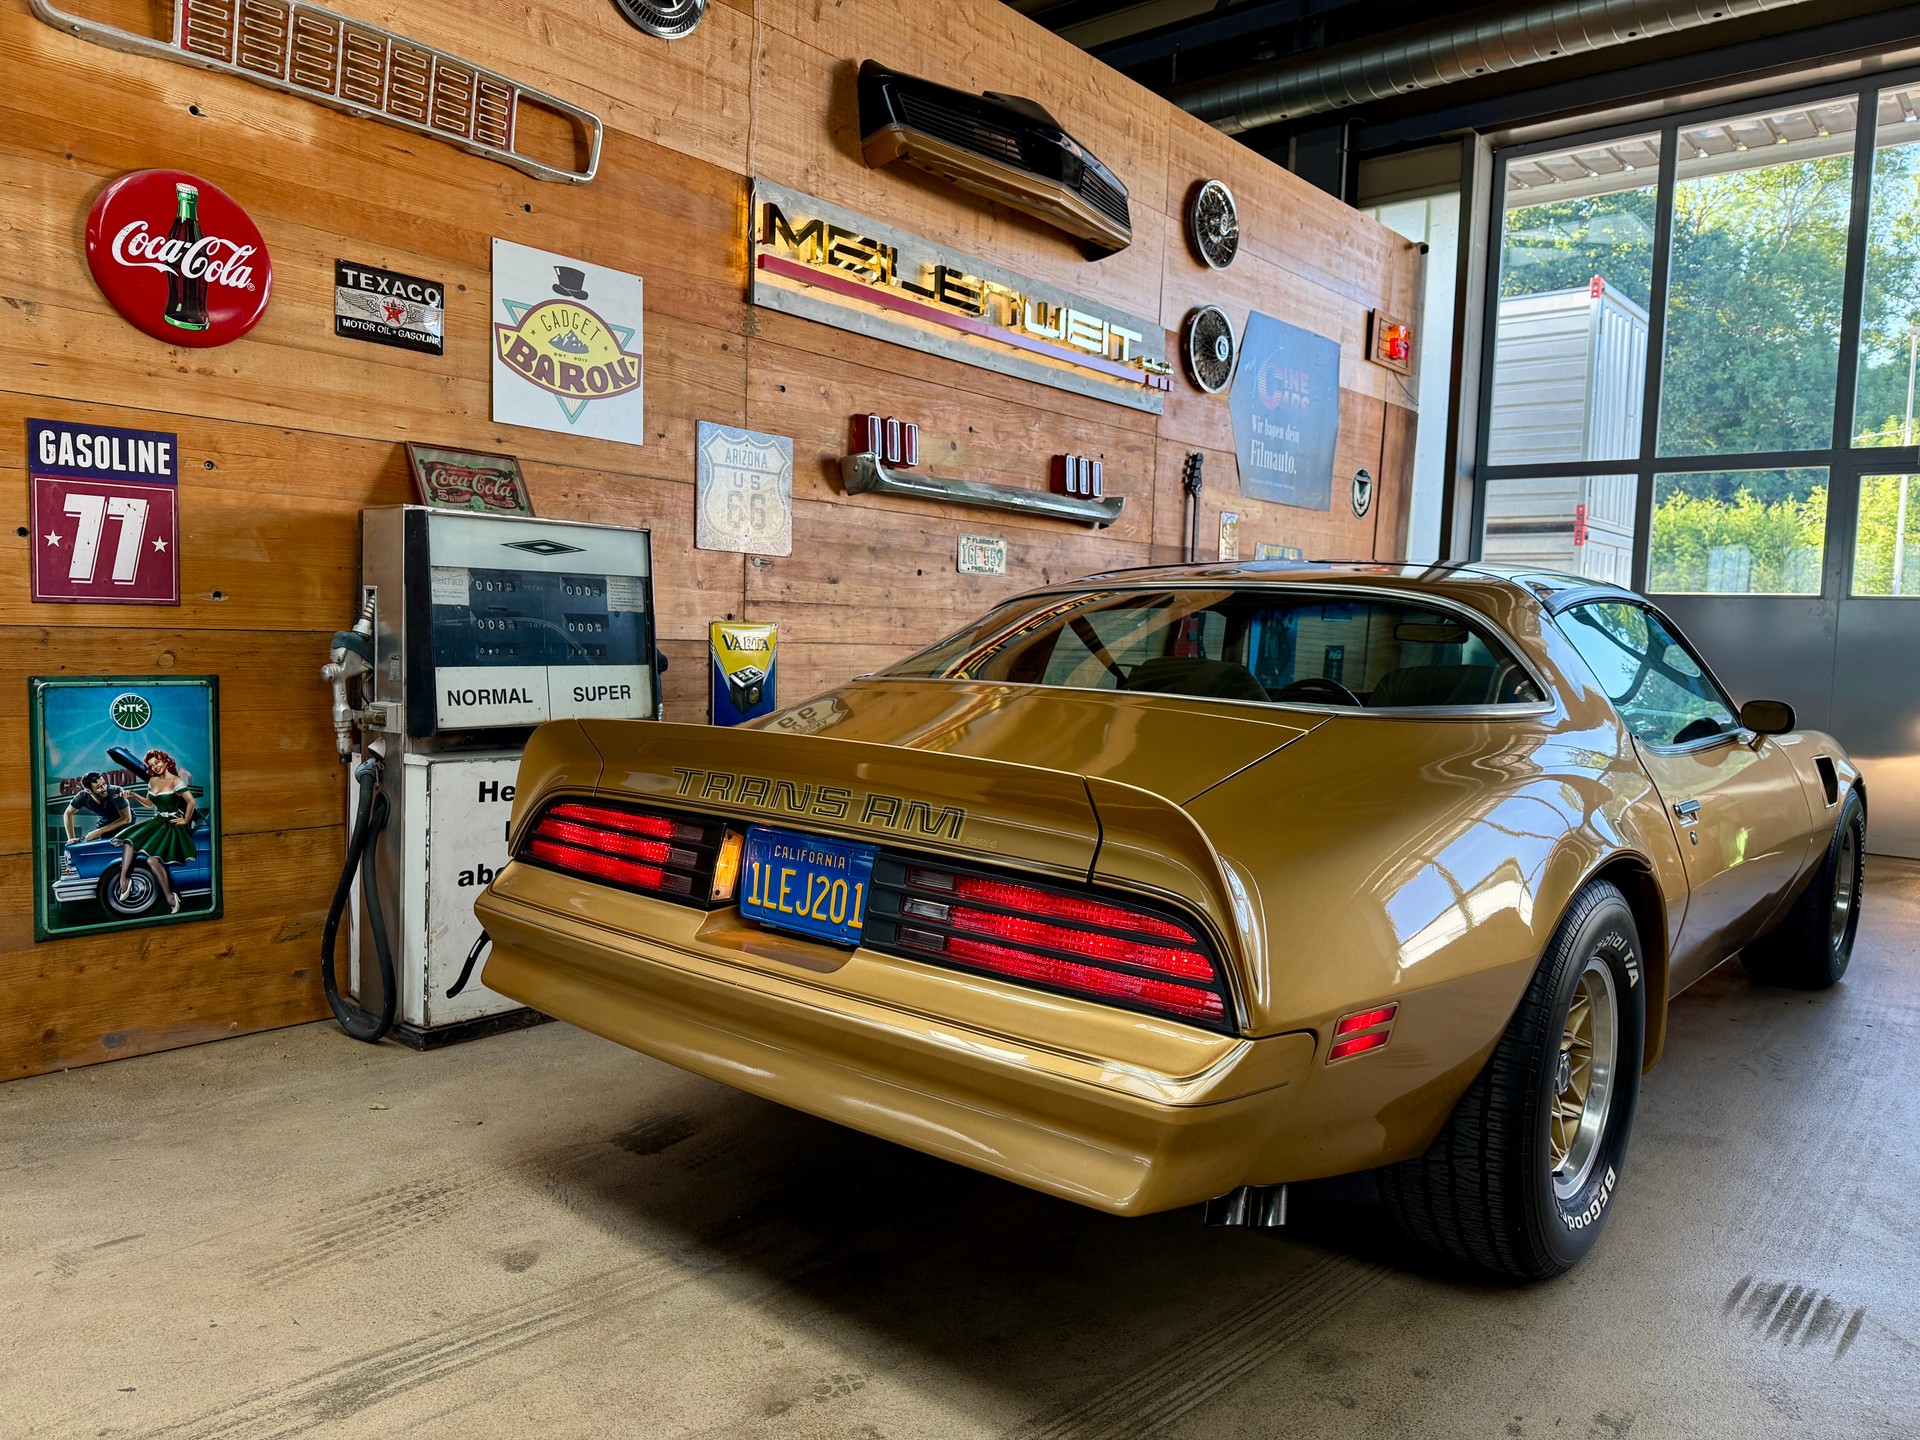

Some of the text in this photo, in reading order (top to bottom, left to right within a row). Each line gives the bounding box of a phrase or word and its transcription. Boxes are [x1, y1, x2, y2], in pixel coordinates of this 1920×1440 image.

[111, 220, 257, 289] Coca-Cola
[341, 268, 440, 304] TEXACO
[342, 318, 441, 347] MOTOR OIL GASOLINE
[540, 309, 601, 341] GADGET
[504, 334, 636, 393] BARON
[553, 352, 569, 360] EST.
[1251, 413, 1300, 444] Wir bauen dein
[39, 429, 171, 475] GASOLINE
[724, 447, 768, 469] ARIZONA
[1250, 439, 1297, 475] Filmauto.
[431, 469, 513, 497] Coca-Cola
[726, 490, 766, 531] 66
[63, 493, 150, 586] 77
[722, 633, 770, 651] VARTA
[118, 703, 144, 714] NTK
[446, 687, 534, 707] NORMAL
[573, 684, 632, 703] SUPER
[101, 768, 138, 787] ATION
[478, 780, 516, 803] He
[673, 766, 968, 842] TRANS AM
[774, 844, 846, 869] CALIFORNIA
[457, 863, 500, 887] ab
[748, 861, 863, 929] 1LEJ201
[1623, 945, 1640, 989] T/A
